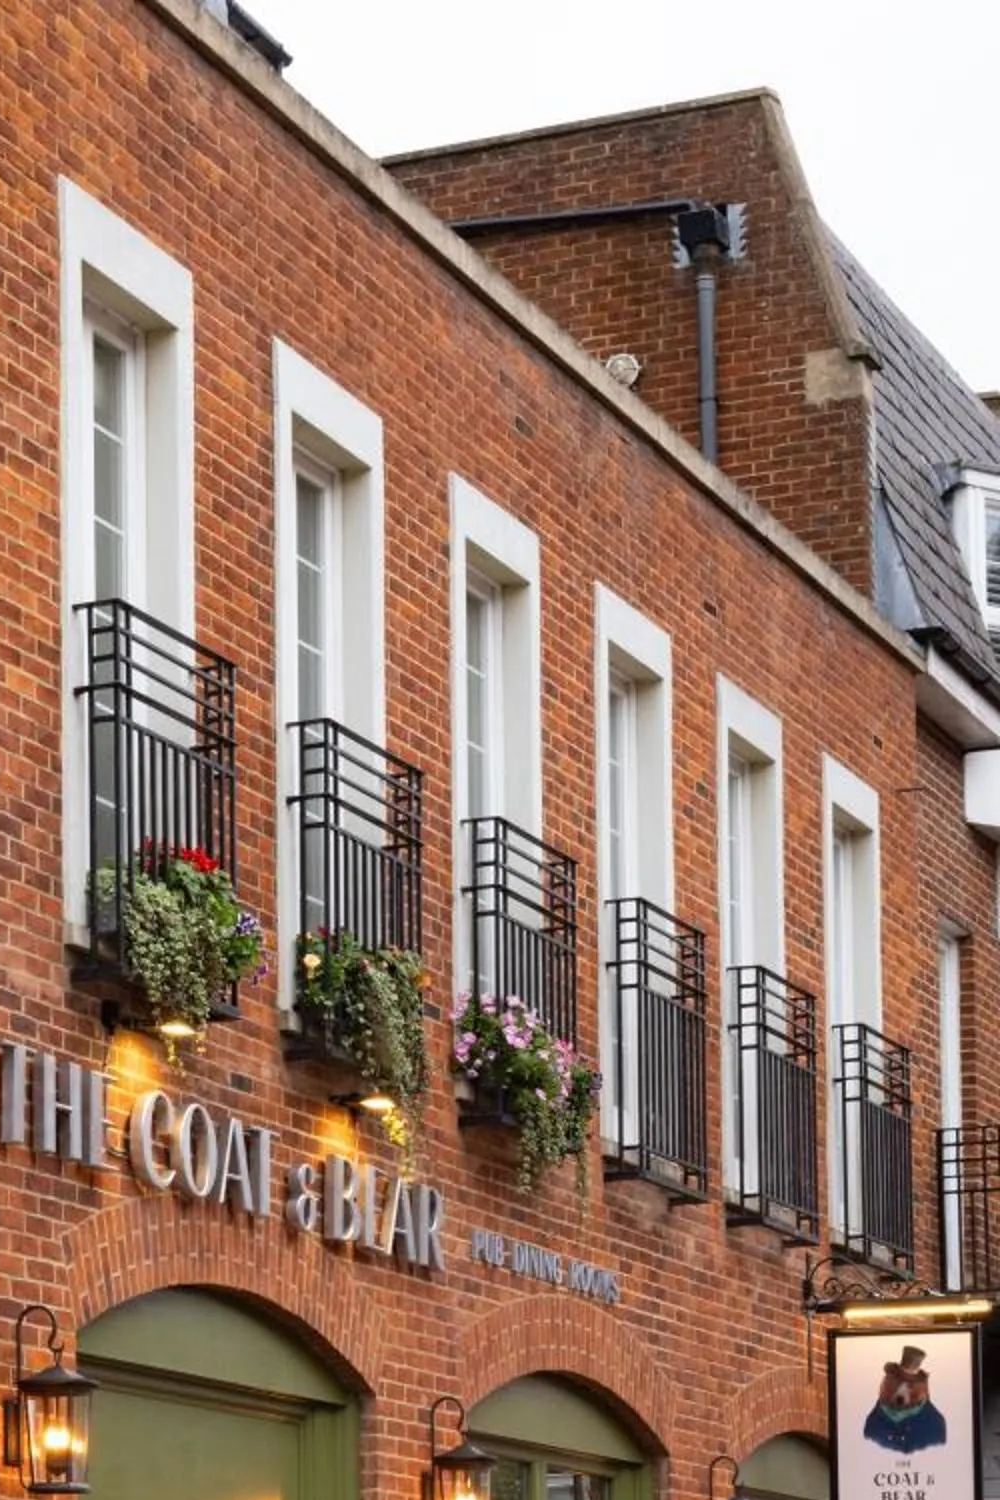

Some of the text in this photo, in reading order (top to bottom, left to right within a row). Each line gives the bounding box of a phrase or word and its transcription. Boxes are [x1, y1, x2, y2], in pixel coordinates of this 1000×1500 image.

[130, 1090, 281, 1217] COAT
[286, 1163, 322, 1231] &
[324, 1153, 446, 1272] BEAR
[471, 1229, 621, 1305] PUB DINING ROOMS
[873, 1471, 923, 1487] COAT
